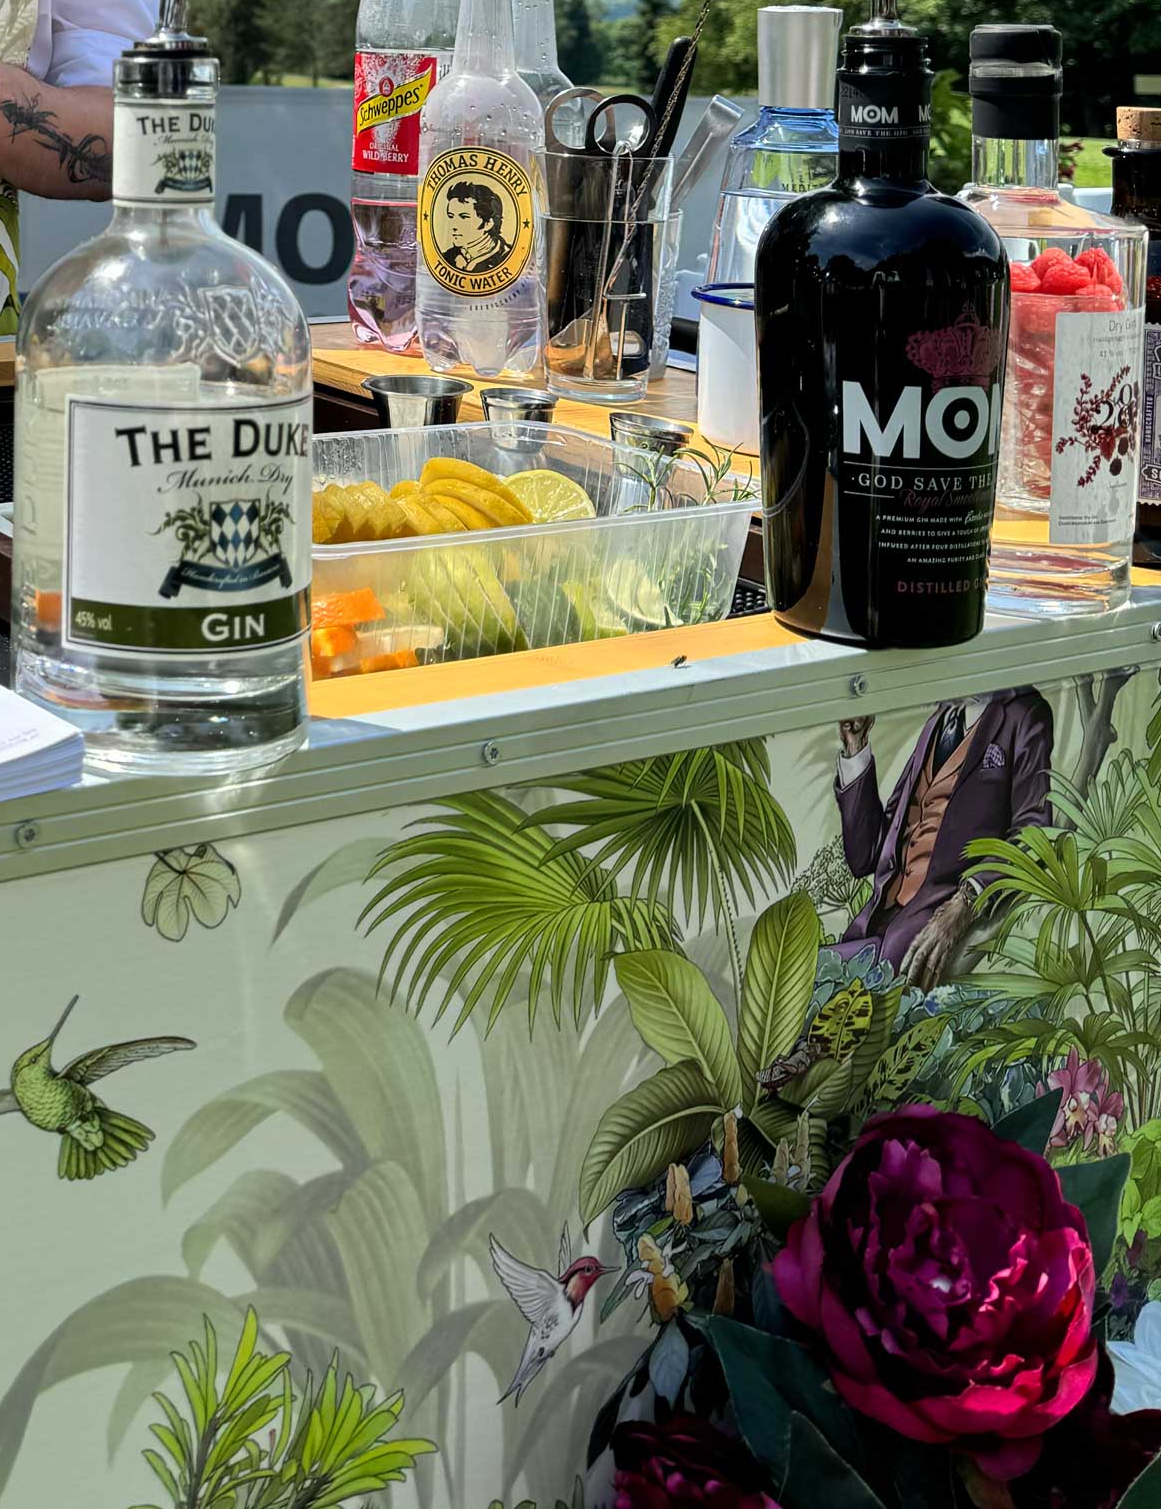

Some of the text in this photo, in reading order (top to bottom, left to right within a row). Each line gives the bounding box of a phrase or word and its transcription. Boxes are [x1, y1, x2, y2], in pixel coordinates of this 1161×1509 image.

[359, 87, 420, 126] Schweppes
[851, 105, 899, 124] MOM
[136, 116, 180, 135] THE
[362, 150, 409, 163] WILD BERRY
[427, 154, 528, 198] THOMAS HENRY
[433, 259, 467, 289] TONIC
[470, 267, 513, 290] WATER
[115, 418, 310, 467] THE DUKE
[157, 463, 294, 494] Munich Dry
[857, 473, 992, 490] GOD SAVE THE
[883, 515, 914, 523] PREMIUM
[899, 529, 925, 537] BERRIES
[897, 579, 971, 594] DISTILLED
[74, 610, 112, 631] 45% vol
[201, 612, 266, 642] GIN
